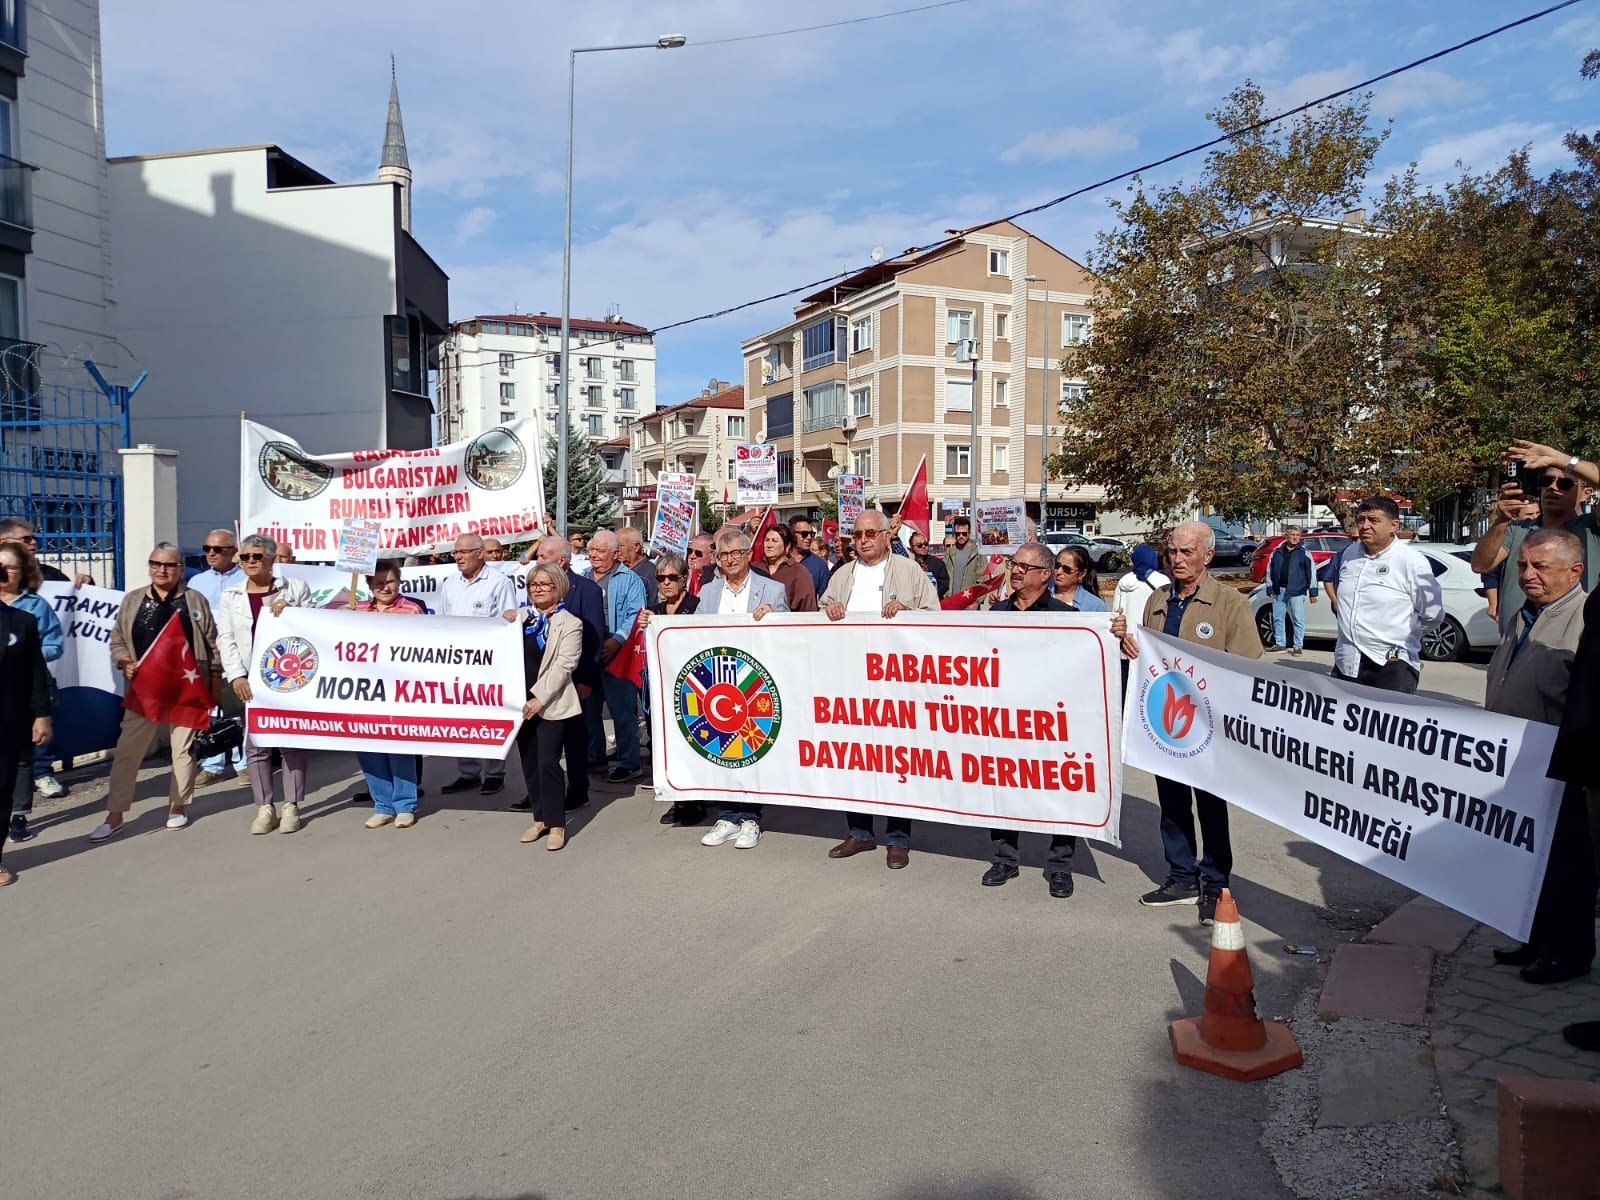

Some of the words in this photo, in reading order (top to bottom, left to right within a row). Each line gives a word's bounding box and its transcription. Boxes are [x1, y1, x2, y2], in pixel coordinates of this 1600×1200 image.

[343, 460, 458, 490] BULGARİSTAN
[329, 492, 392, 520] RUMELİ
[396, 486, 471, 519] TÜRKLERİ
[379, 521, 462, 550] YANIŞMA
[467, 505, 538, 536] DERNEĞİ
[400, 575, 437, 594] arih
[54, 594, 119, 620] TRAKY
[334, 641, 380, 664] 1821
[389, 644, 494, 666] YUNANİSTAN
[866, 647, 1000, 688] BABAESKİ
[315, 676, 387, 702] MORA
[394, 677, 504, 707] KATLİAMI
[1148, 657, 1208, 692] ESKAD
[257, 715, 345, 734] UNUTMADIK
[348, 721, 506, 741] UNUTTURMAYACAĞIZ
[813, 696, 917, 730] BALKAN
[925, 694, 1069, 742] TÜRKLERİ
[1251, 677, 1338, 726] EDİRNE
[1343, 703, 1509, 778] SINIRÖTESİ
[798, 739, 954, 784] DAYANIŞMA
[961, 752, 1096, 793] DERNEĞİ
[1223, 714, 1355, 785] KÜLTÜRLERİ
[1362, 762, 1536, 854] ARAŞTIRMA
[1303, 790, 1412, 861] DERNEĞİ
